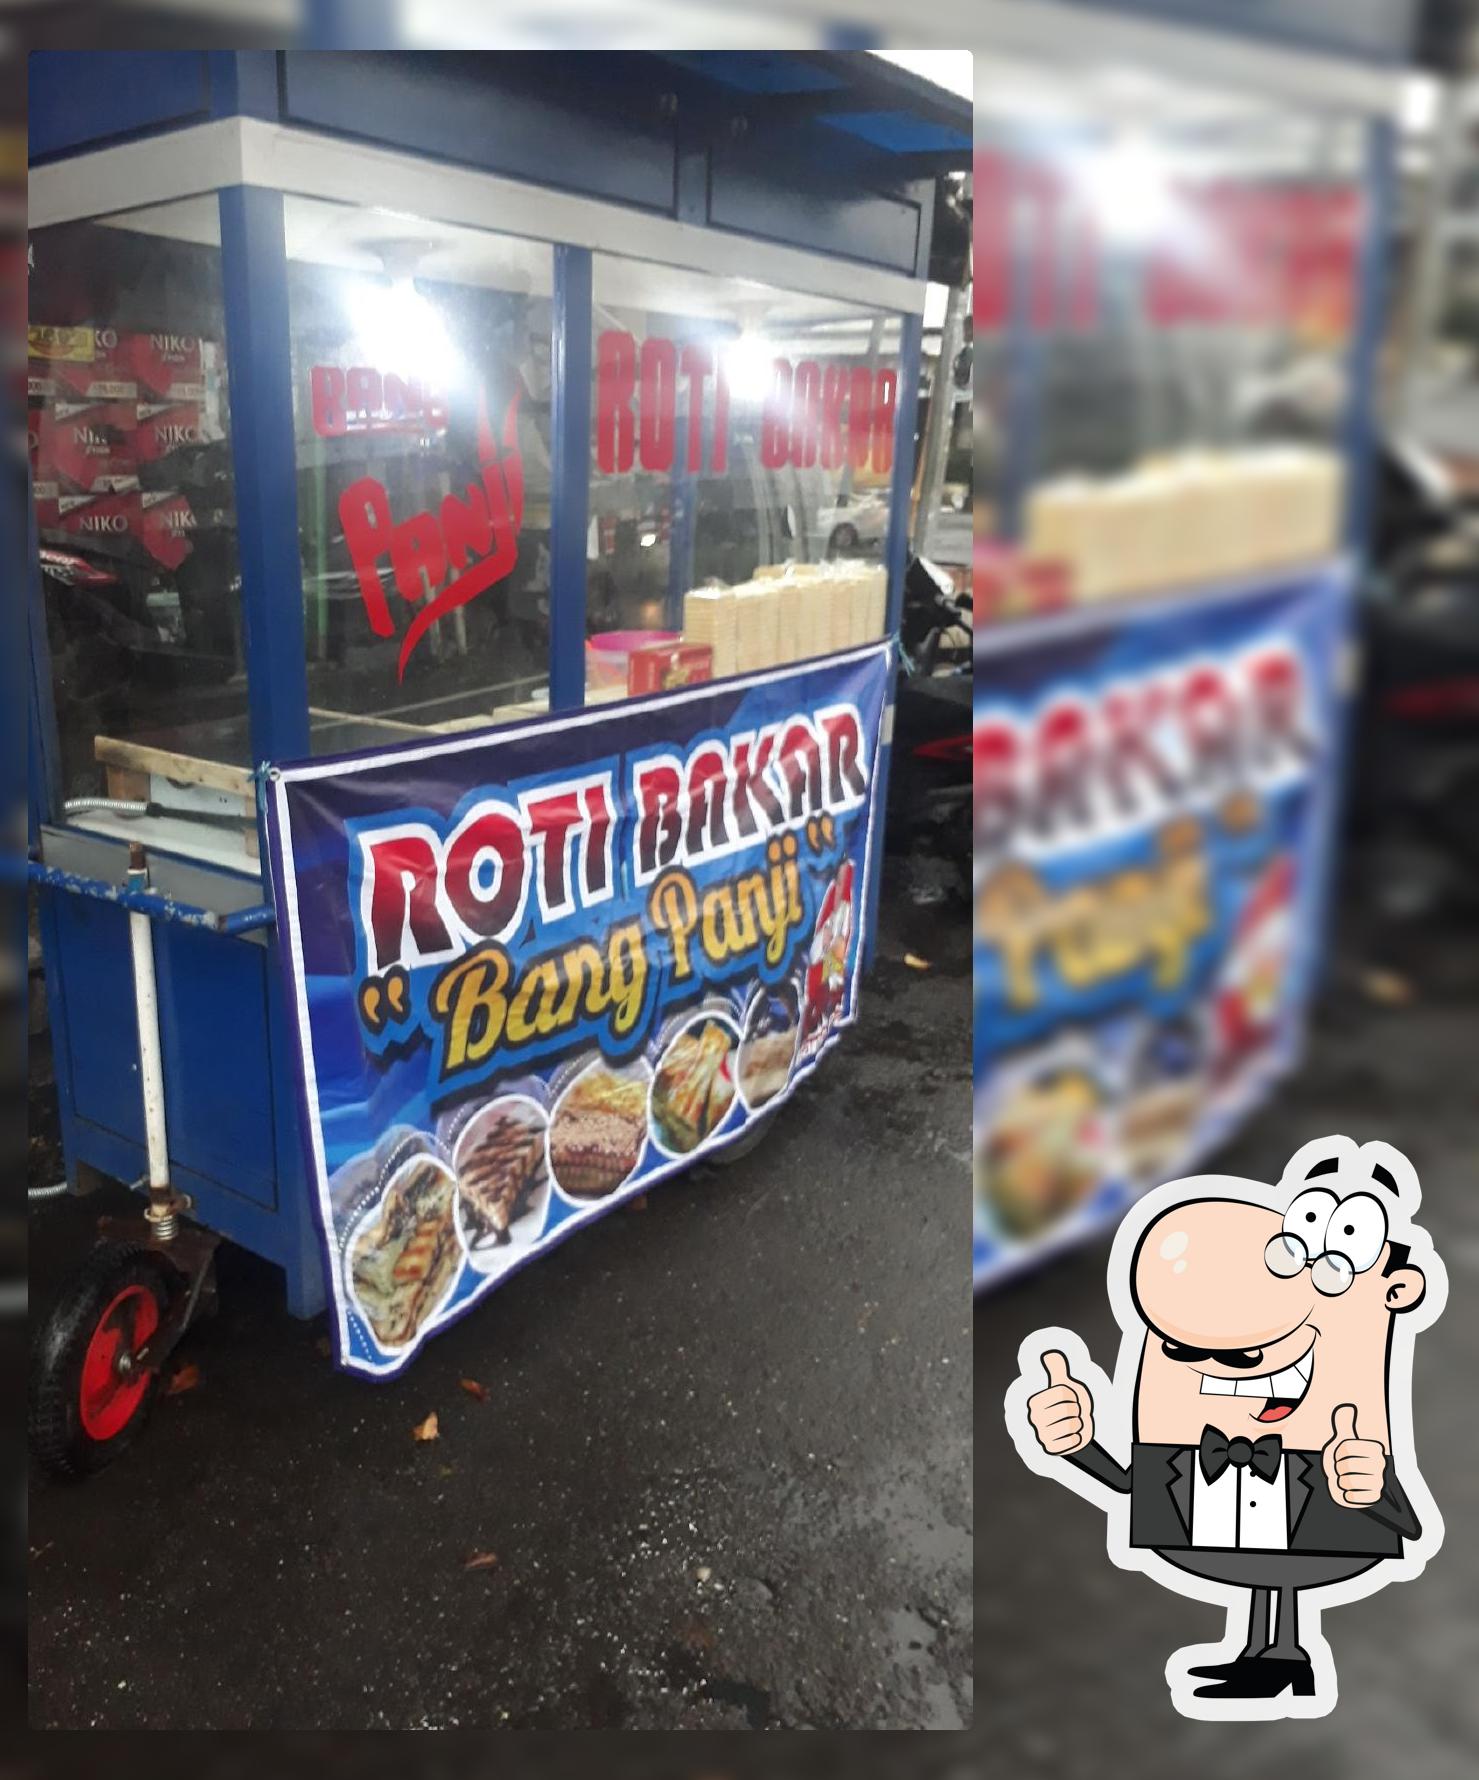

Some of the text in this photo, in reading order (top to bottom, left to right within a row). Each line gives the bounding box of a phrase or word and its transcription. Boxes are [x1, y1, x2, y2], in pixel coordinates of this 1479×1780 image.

[150, 333, 197, 350] NIKO
[596, 330, 728, 474] ROTI
[79, 515, 129, 532] NIKO
[362, 708, 865, 975] ROTI BAKAR
[430, 921, 648, 1069] Bang
[649, 834, 802, 979] Panji
